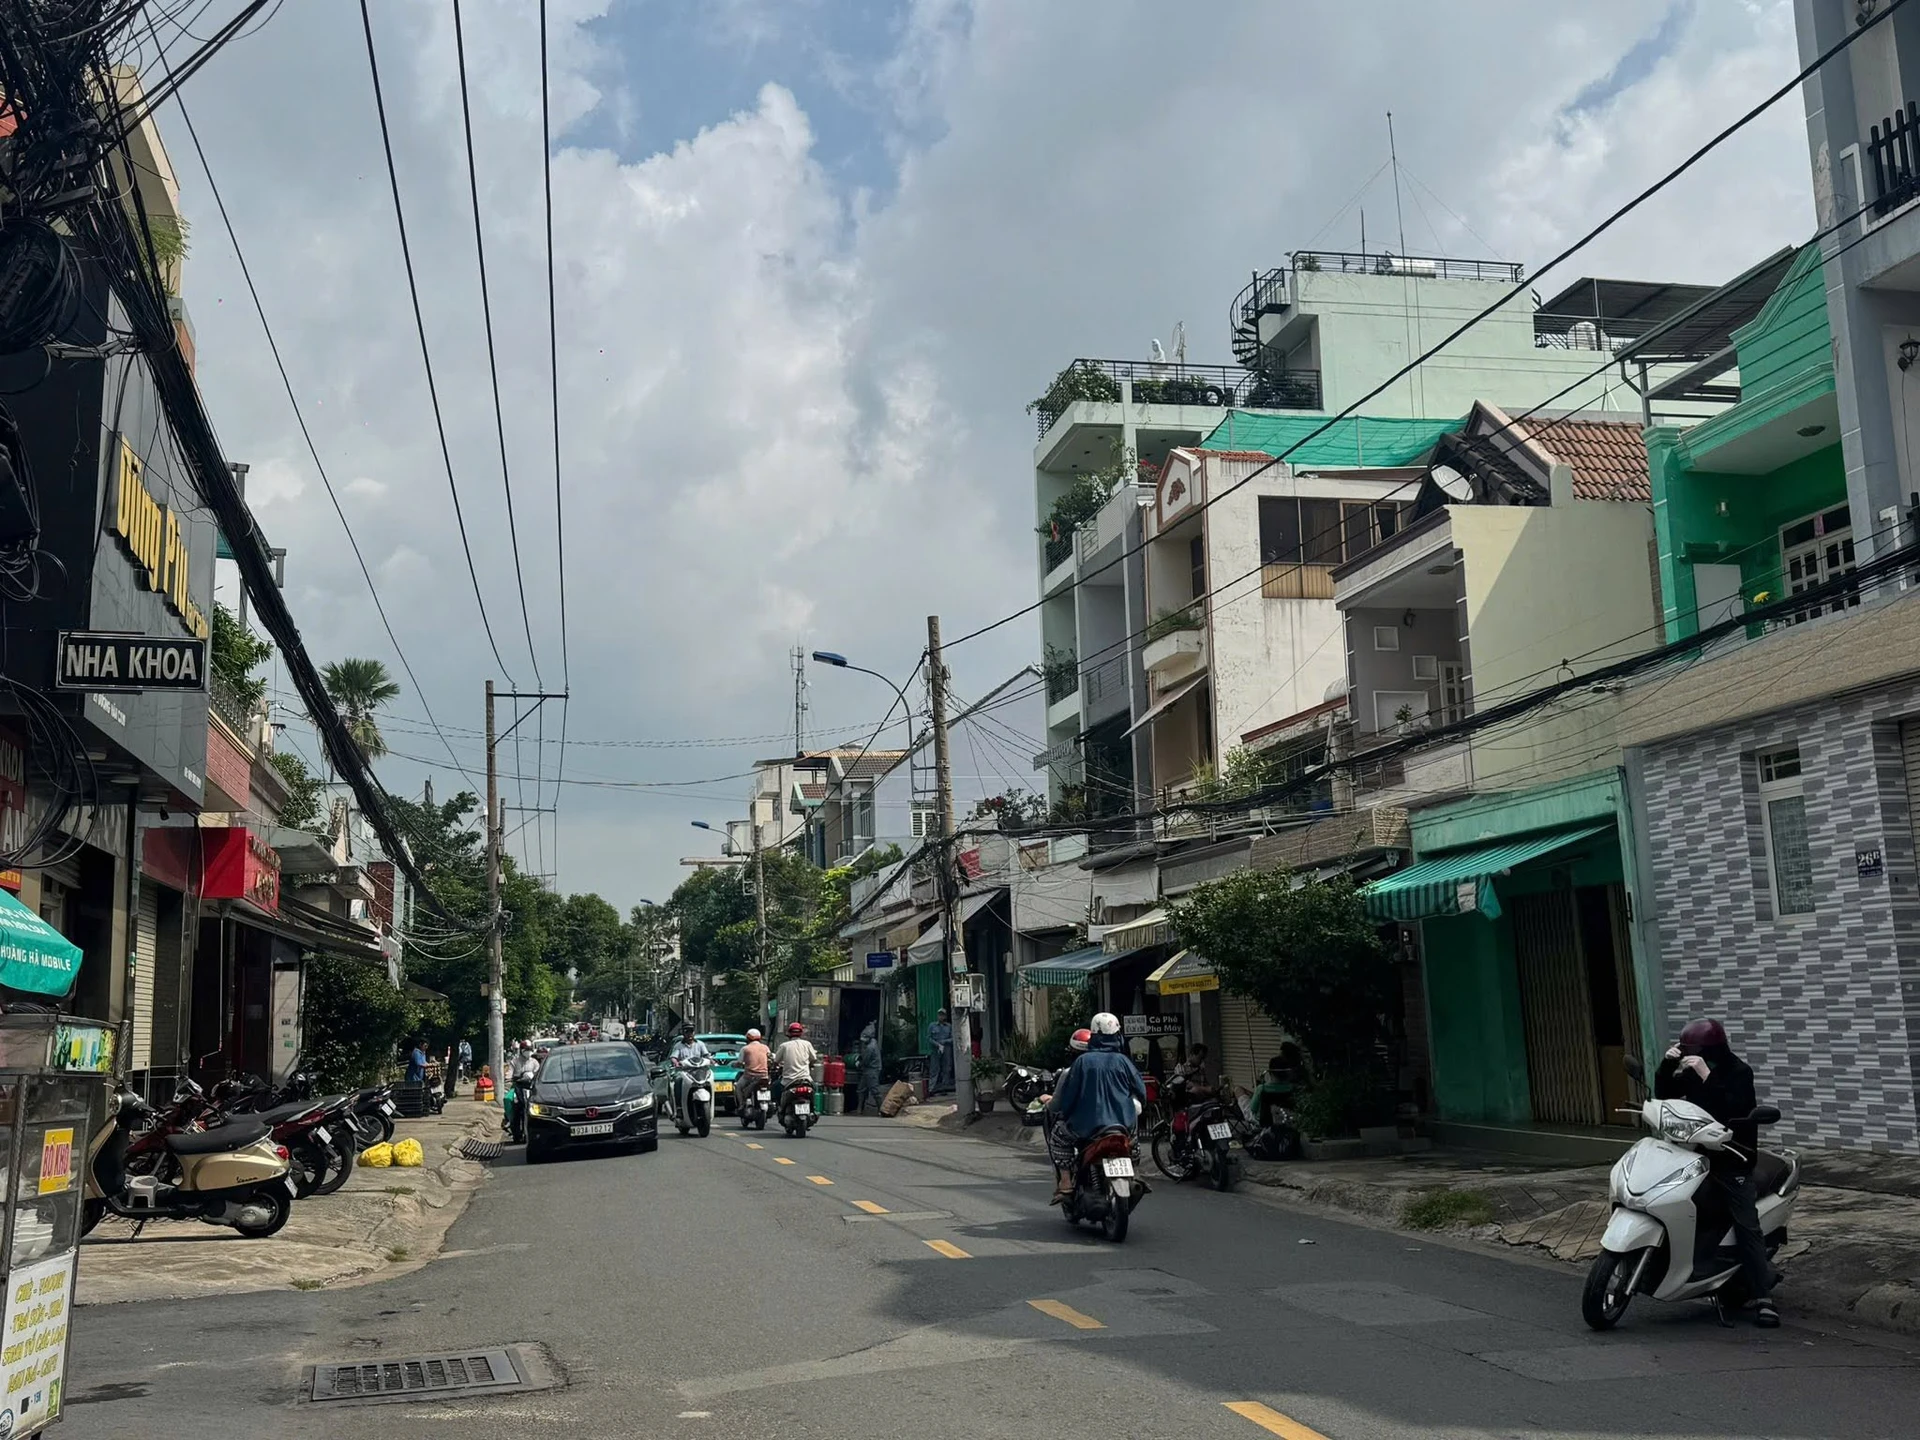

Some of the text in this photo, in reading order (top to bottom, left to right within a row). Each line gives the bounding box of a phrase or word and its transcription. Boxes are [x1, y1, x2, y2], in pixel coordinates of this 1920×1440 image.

[163, 503, 188, 617] Piu
[65, 644, 197, 680] NHA KHOA
[1857, 851, 1880, 866] 26B
[0, 943, 72, 972] HOÀNG HÀ MOBILE
